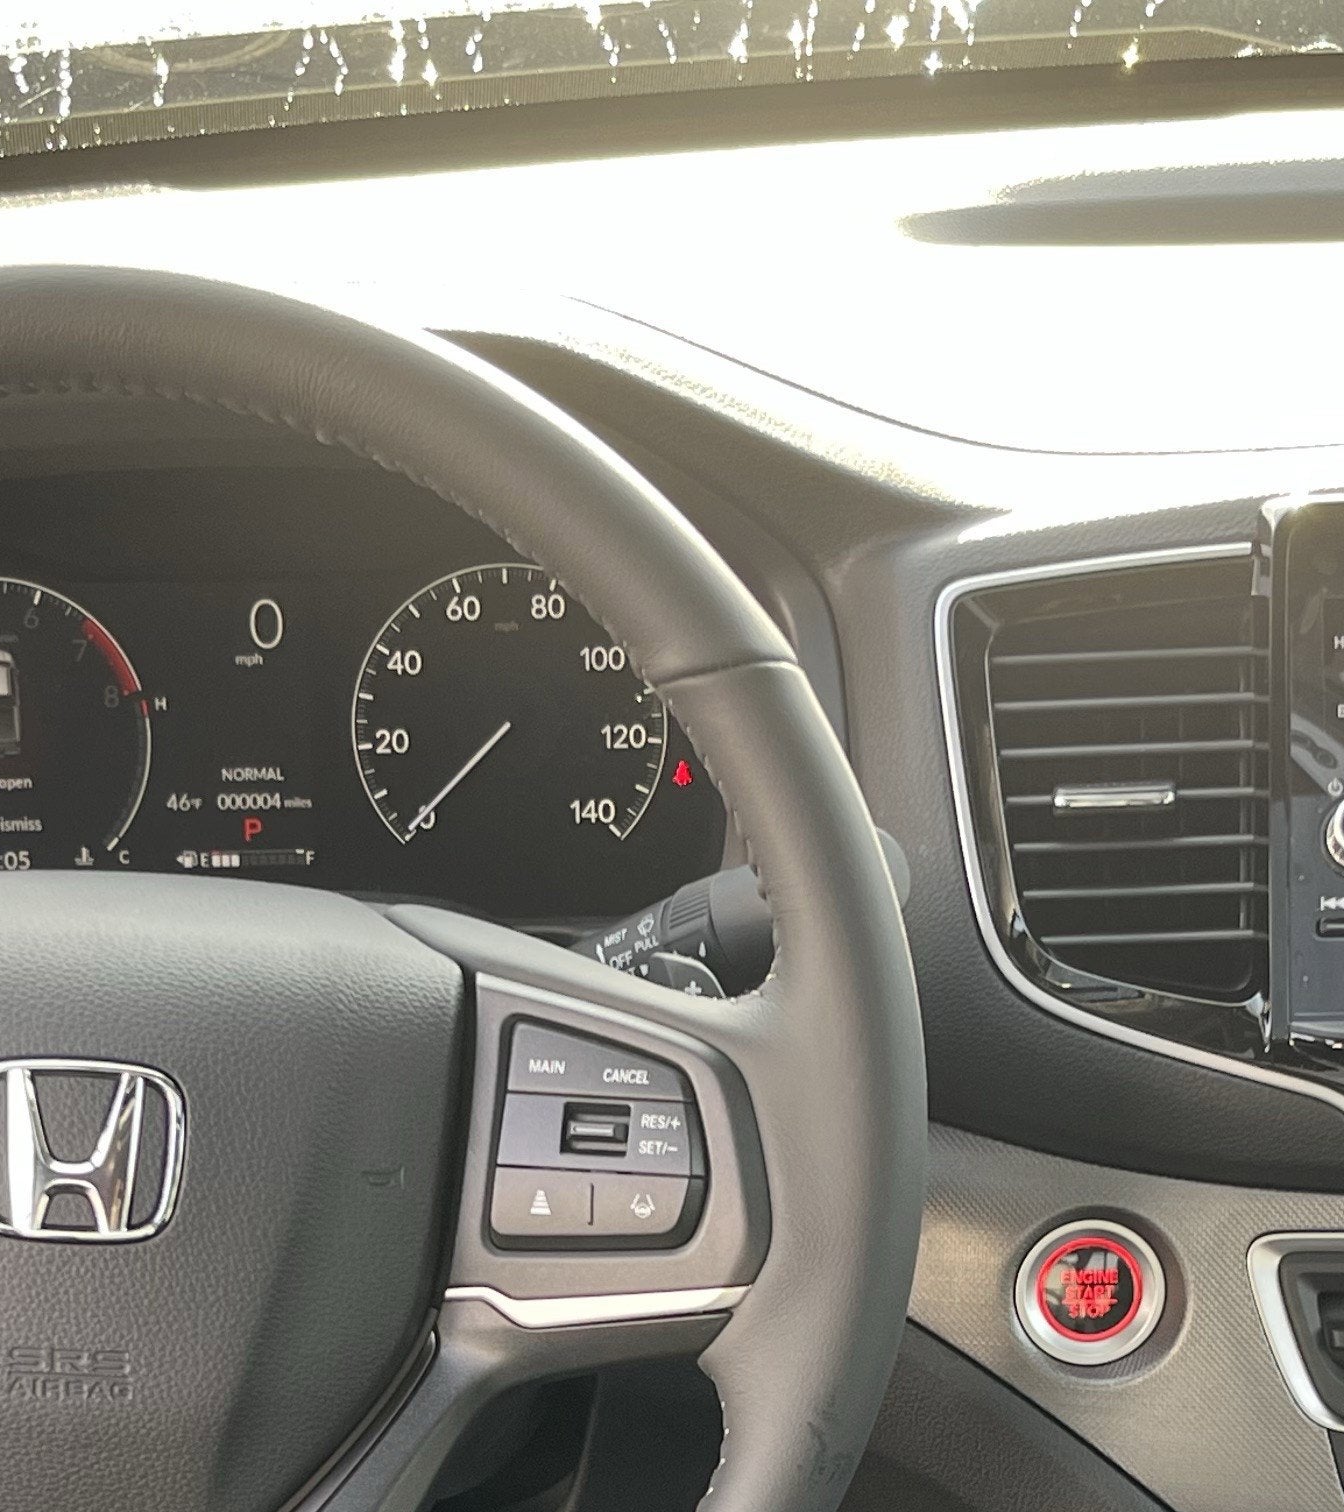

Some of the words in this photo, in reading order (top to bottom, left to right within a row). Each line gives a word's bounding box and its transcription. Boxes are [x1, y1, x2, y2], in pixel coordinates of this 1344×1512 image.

[446, 597, 482, 622] 60
[530, 595, 566, 620] 80
[249, 599, 284, 649] 0
[235, 652, 263, 668] mph
[387, 650, 422, 676] 40
[580, 646, 626, 672] 100
[375, 730, 409, 755] 20
[601, 725, 646, 749] 120
[221, 767, 285, 782] NORMAL
[217, 792, 282, 811] 000004
[570, 799, 615, 824] 140
[243, 817, 263, 842] P
[200, 852, 209, 867] E
[306, 850, 315, 866] F
[528, 1059, 566, 1075] MAIN
[602, 1068, 650, 1085] CANCEL
[1060, 1270, 1118, 1284] ENGINE
[1065, 1285, 1115, 1300] START
[1068, 1302, 1112, 1319] STOP
[6, 1347, 131, 1374] SRS
